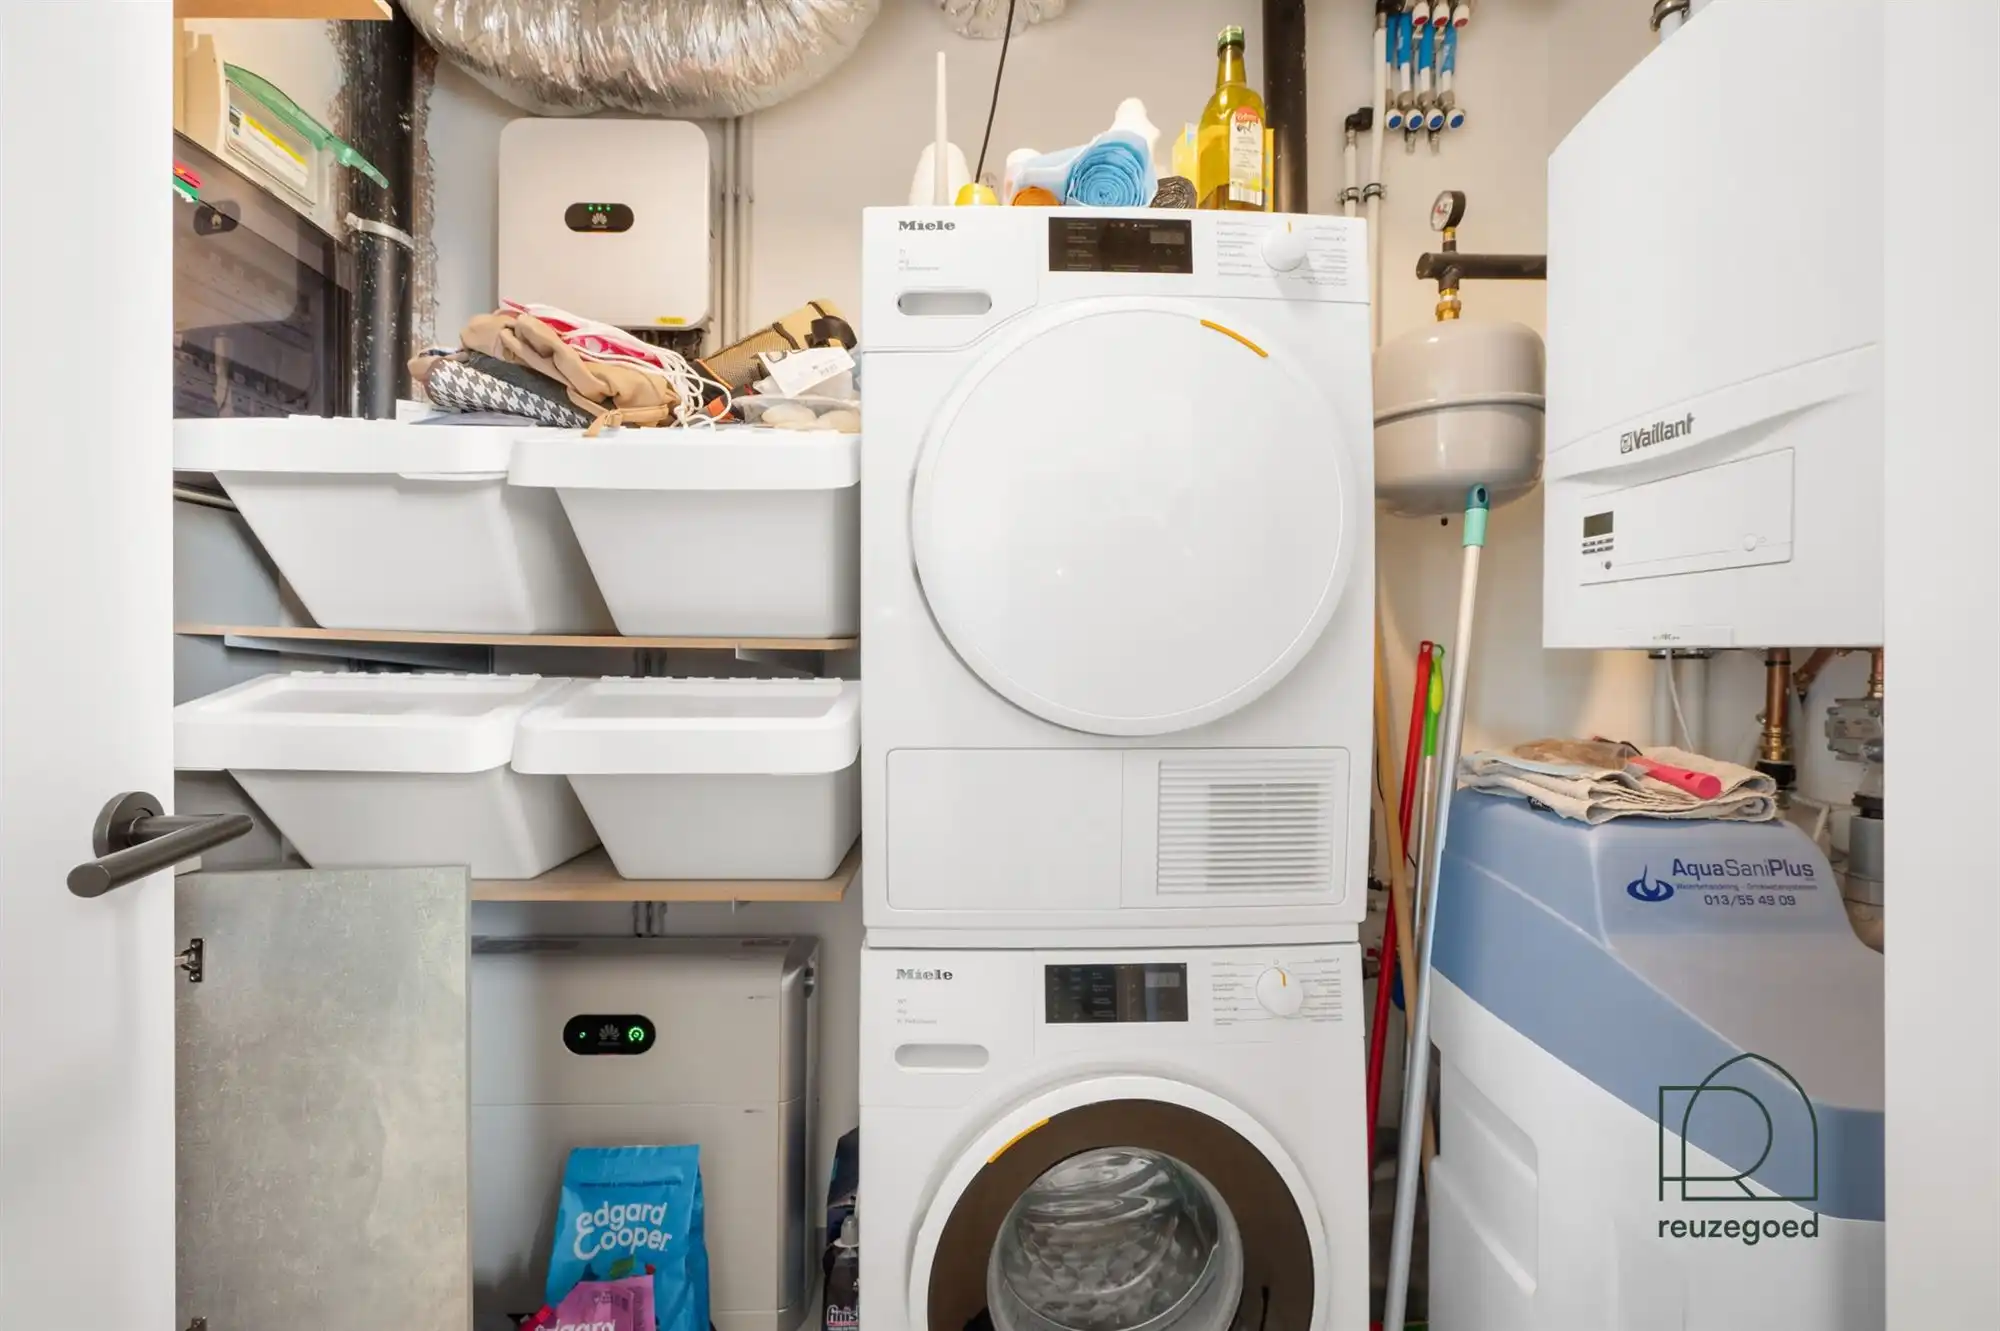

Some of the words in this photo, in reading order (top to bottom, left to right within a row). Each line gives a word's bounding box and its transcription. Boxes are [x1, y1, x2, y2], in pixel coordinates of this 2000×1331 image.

[898, 220, 956, 231] Miele
[1632, 412, 1696, 449] Vaillant
[1671, 858, 1815, 881] AquaSaniPlus
[1704, 894, 1755, 907] 013/55
[1758, 894, 1776, 906] 49
[1778, 894, 1797, 906] 09
[896, 968, 953, 980] Miele
[576, 1201, 668, 1234] edgard
[573, 1227, 673, 1261] Cooper
[827, 1304, 859, 1322] finis
